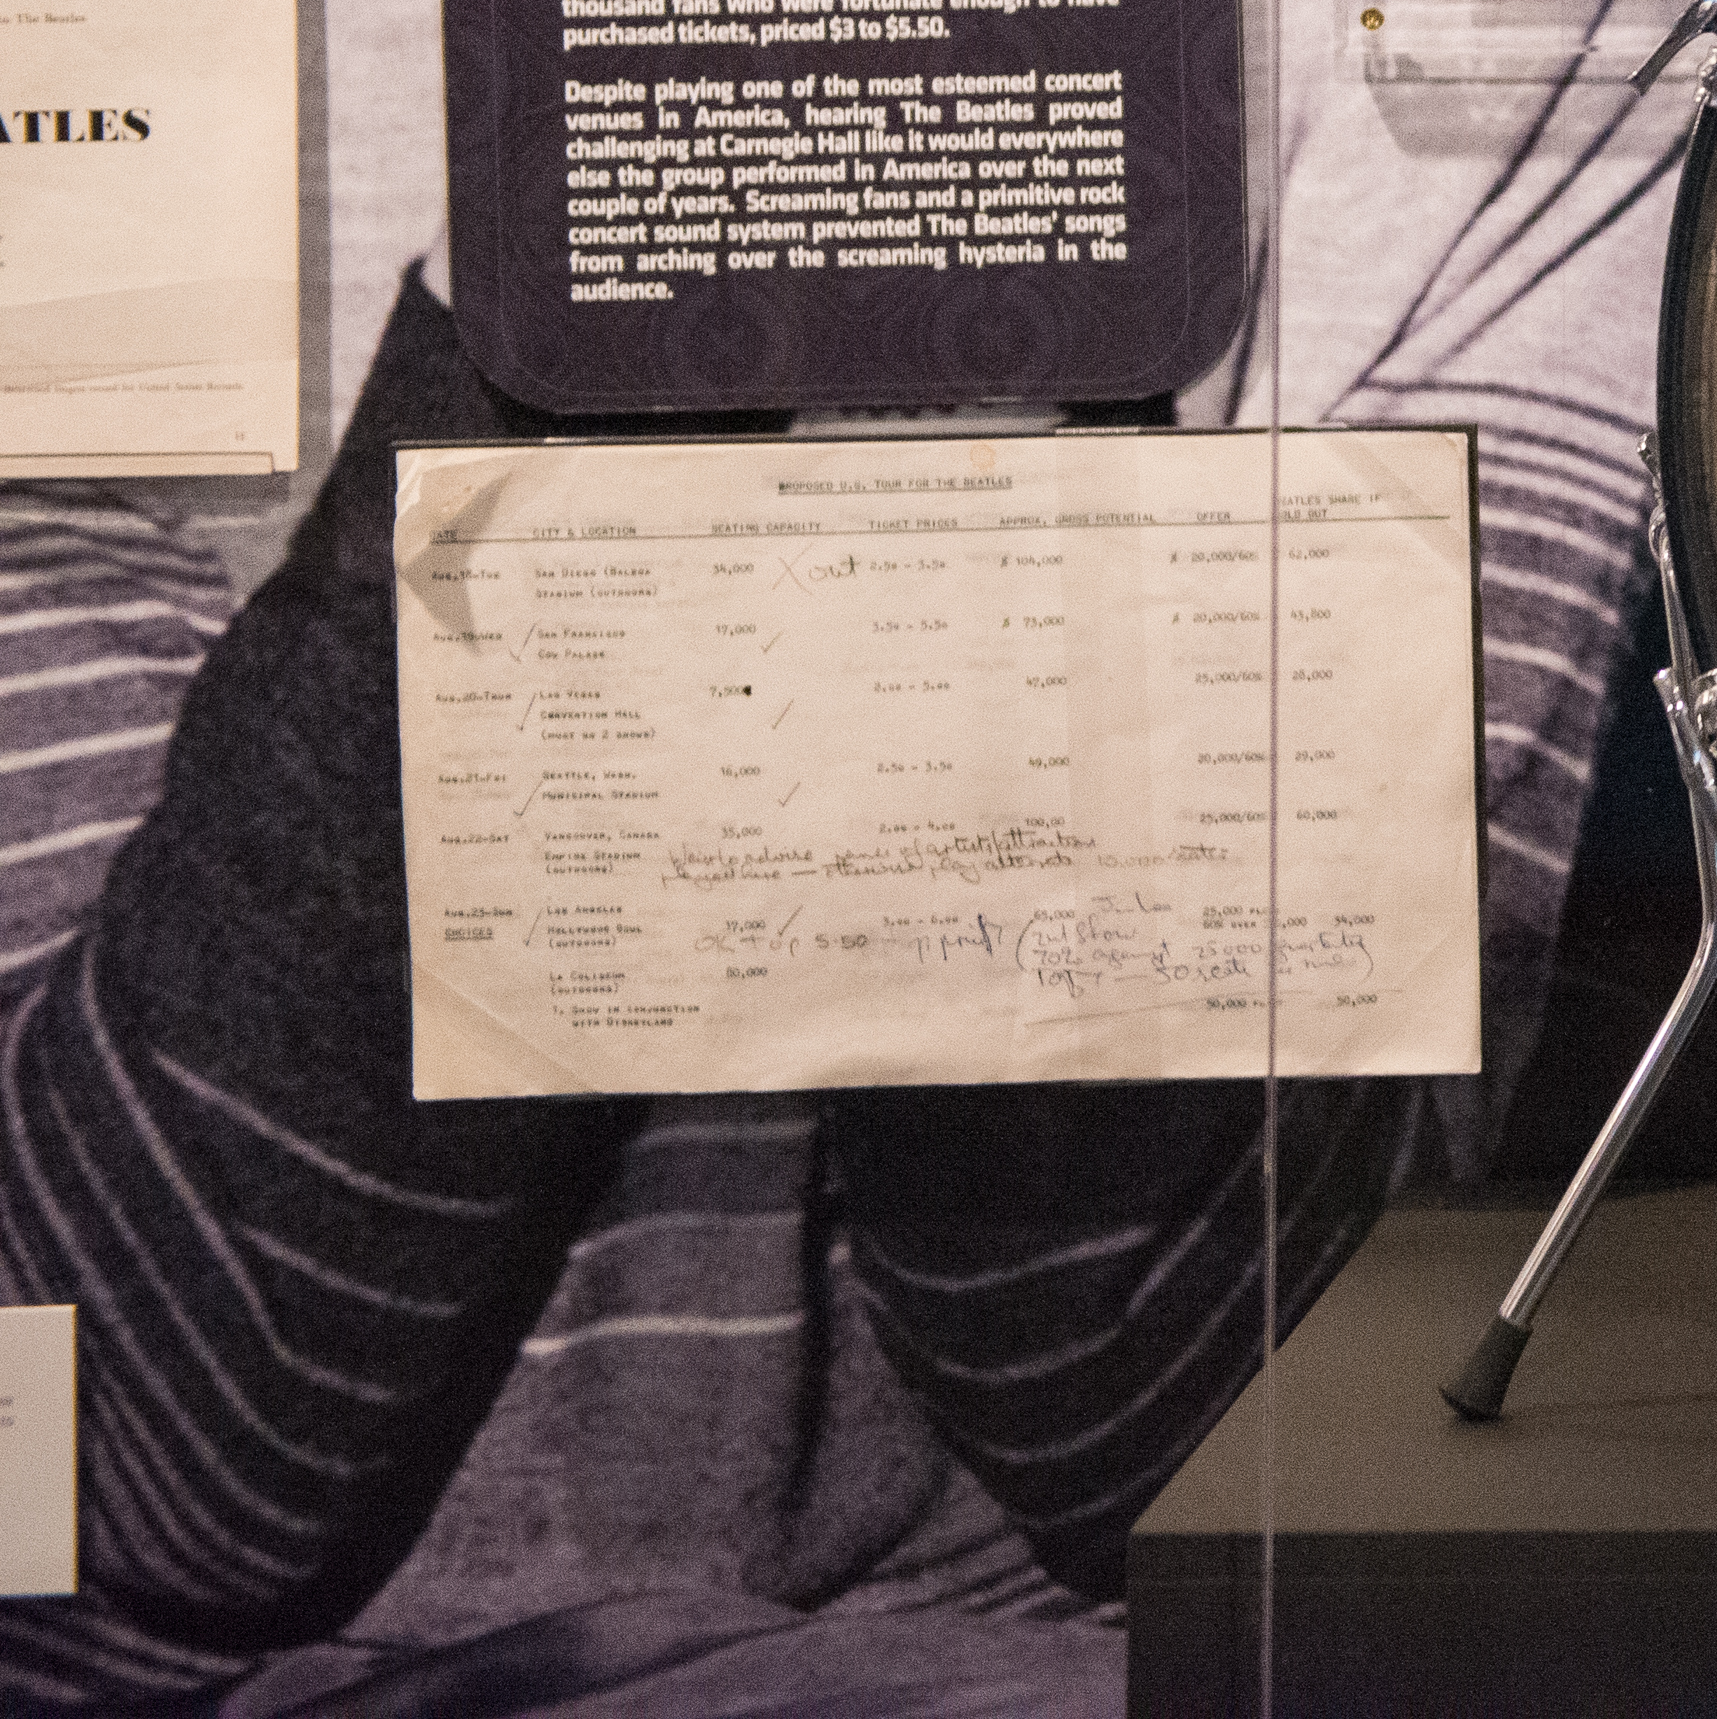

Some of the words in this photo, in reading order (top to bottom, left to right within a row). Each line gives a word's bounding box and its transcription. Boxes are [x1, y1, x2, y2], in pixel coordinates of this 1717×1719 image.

[564, 79, 647, 105] Despite
[654, 77, 735, 105] playing
[741, 80, 784, 99] one
[790, 74, 816, 98] of
[822, 74, 860, 97] the
[867, 74, 924, 96] most
[931, 70, 1037, 95] esteemed
[1043, 70, 1123, 93] concert
[570, 277, 674, 302] audience.
